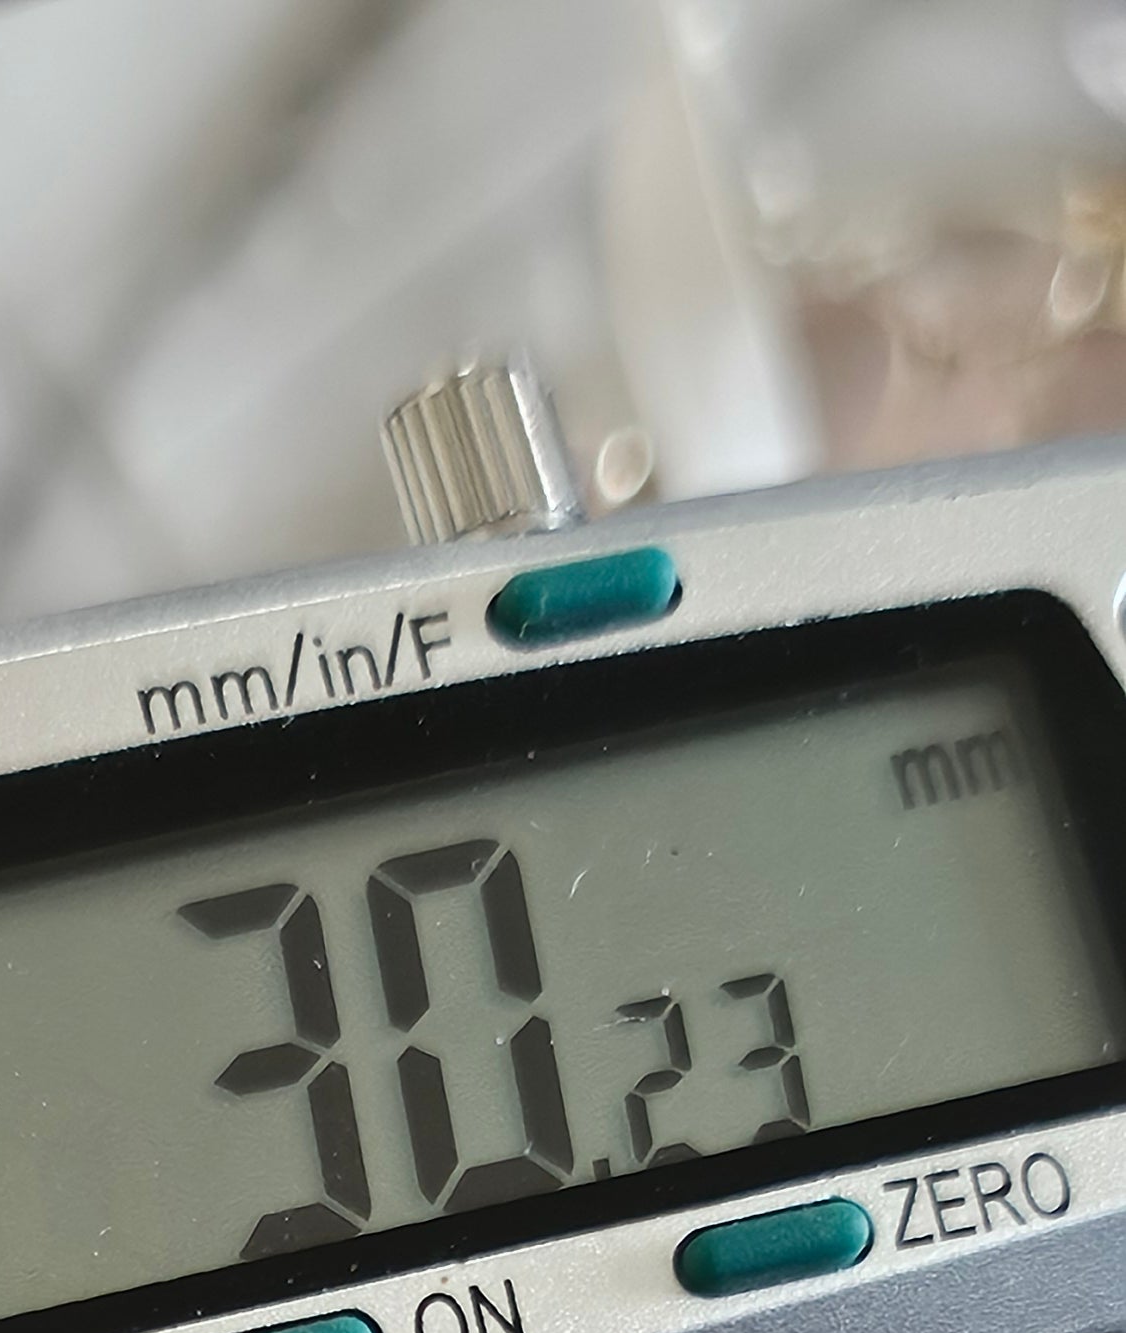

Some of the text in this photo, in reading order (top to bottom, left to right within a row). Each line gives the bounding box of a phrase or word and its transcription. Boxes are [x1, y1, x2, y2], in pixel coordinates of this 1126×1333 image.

[136, 609, 451, 736] mm/in/F
[890, 729, 1022, 810] mm
[176, 838, 812, 1261] 30.23
[886, 1152, 1074, 1251] ZERO
